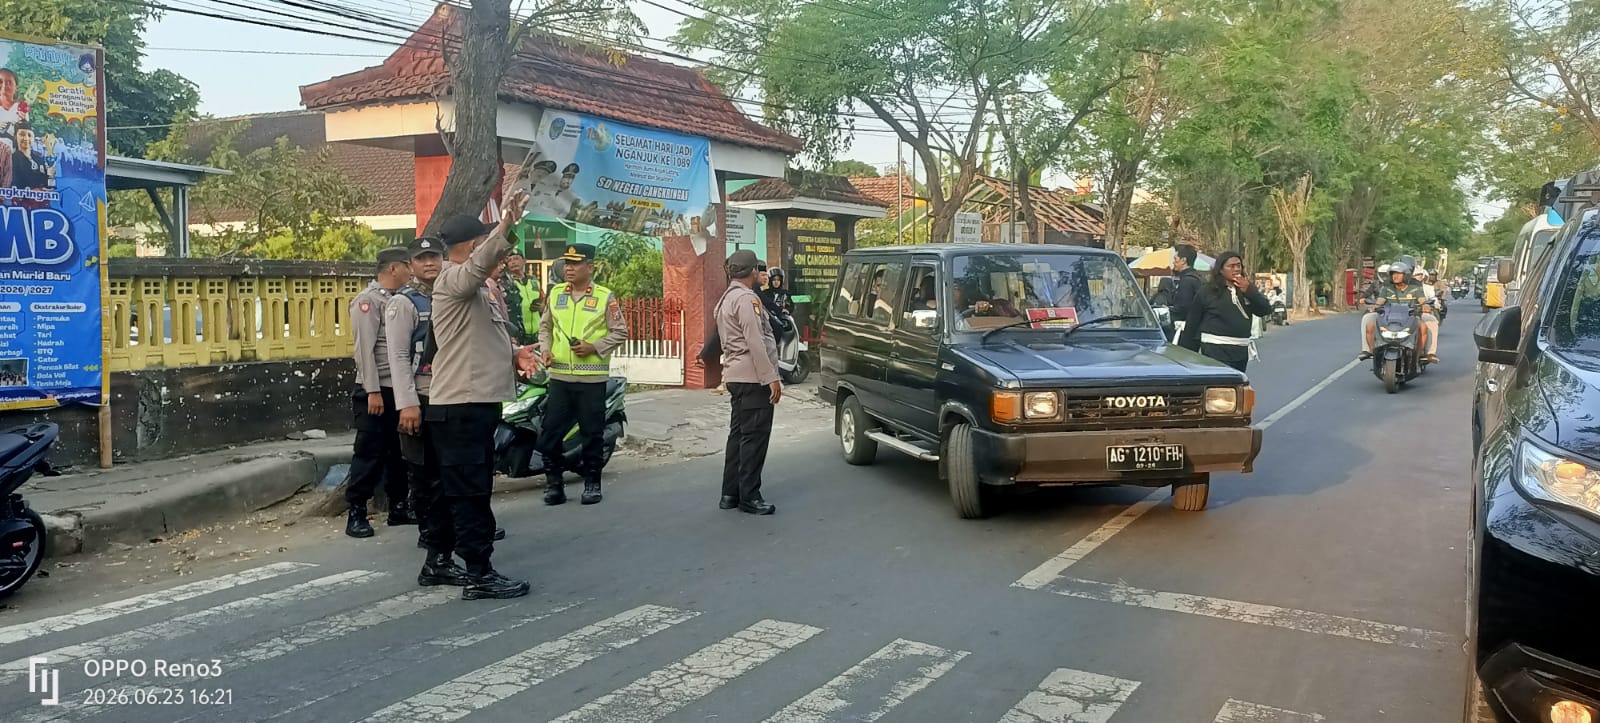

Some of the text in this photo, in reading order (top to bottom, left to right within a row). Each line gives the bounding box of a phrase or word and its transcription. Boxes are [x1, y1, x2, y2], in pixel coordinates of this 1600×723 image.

[615, 134, 652, 149] SELAMAT
[655, 141, 674, 154] HARI
[675, 144, 692, 156] JADI
[616, 148, 691, 168] NGANJUK KE 1089
[0, 186, 59, 201] ngkringan
[598, 176, 612, 188] SD
[612, 180, 642, 196] NEGERI
[12, 271, 44, 280] Murid
[46, 272, 71, 281] Baru
[37, 323, 55, 331] Mipa
[37, 348, 53, 356] BTQ
[1106, 396, 1166, 408] TOYOTA
[1110, 446, 1179, 463] AG 1210 FH
